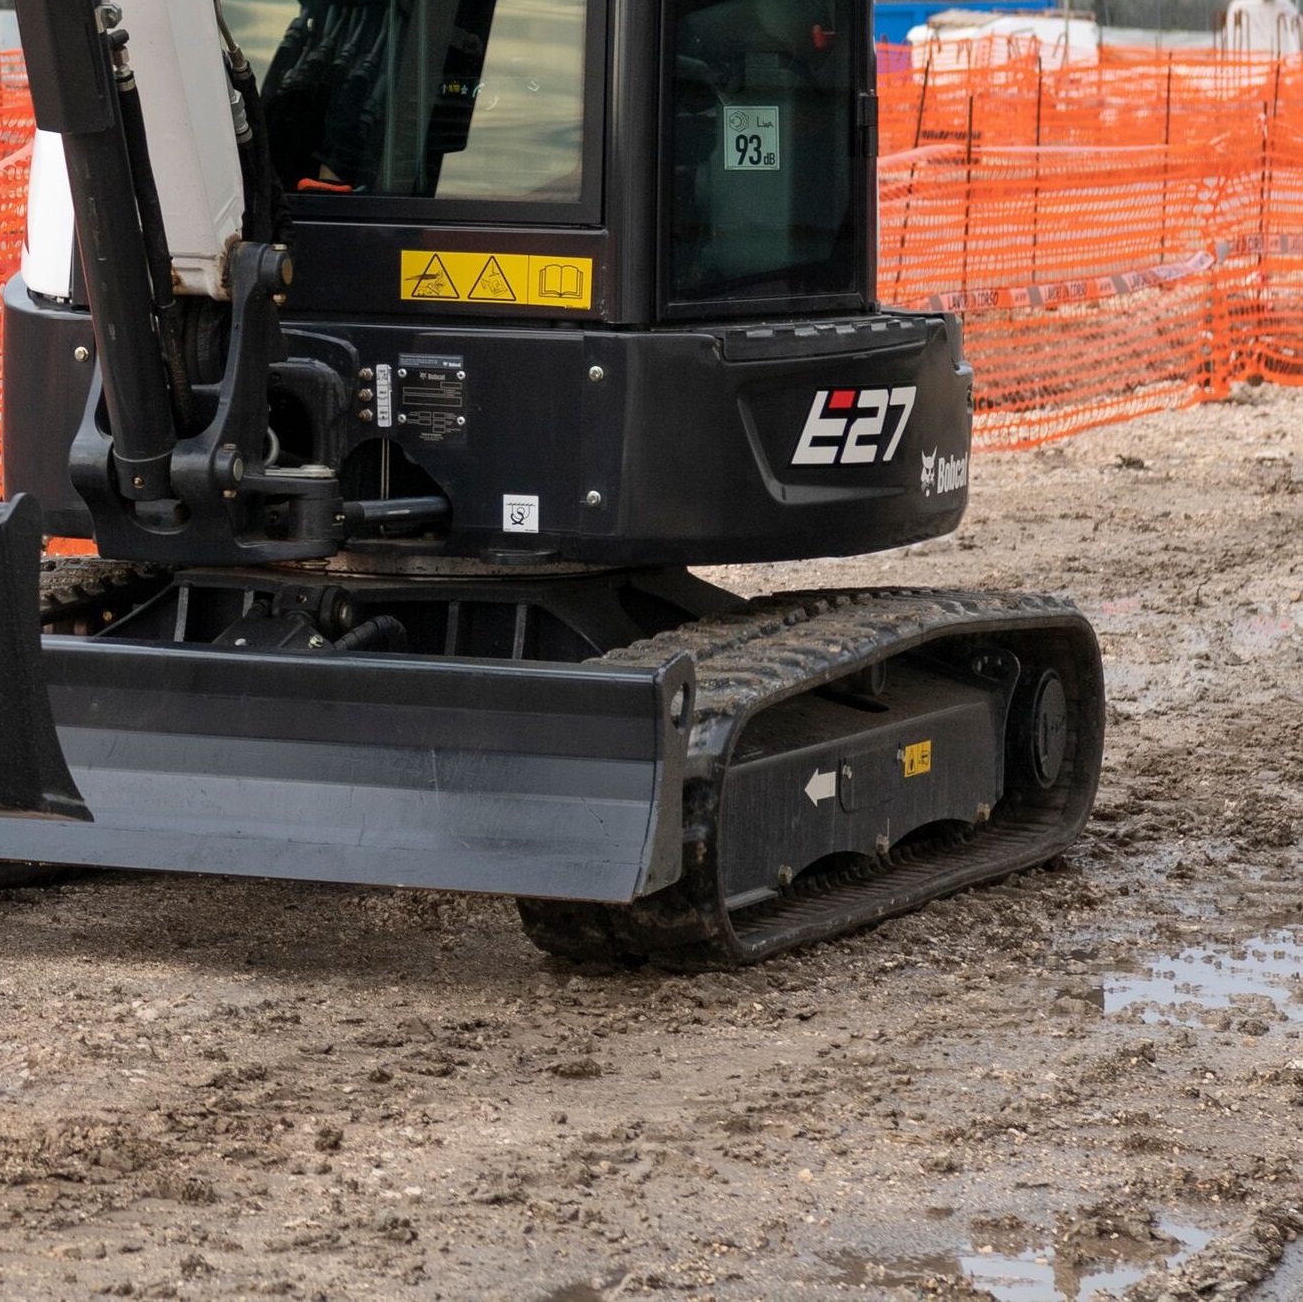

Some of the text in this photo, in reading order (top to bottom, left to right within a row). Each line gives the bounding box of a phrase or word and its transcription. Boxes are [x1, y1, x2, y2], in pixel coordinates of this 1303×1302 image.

[735, 134, 776, 165] 93 dB
[791, 386, 917, 465] E27
